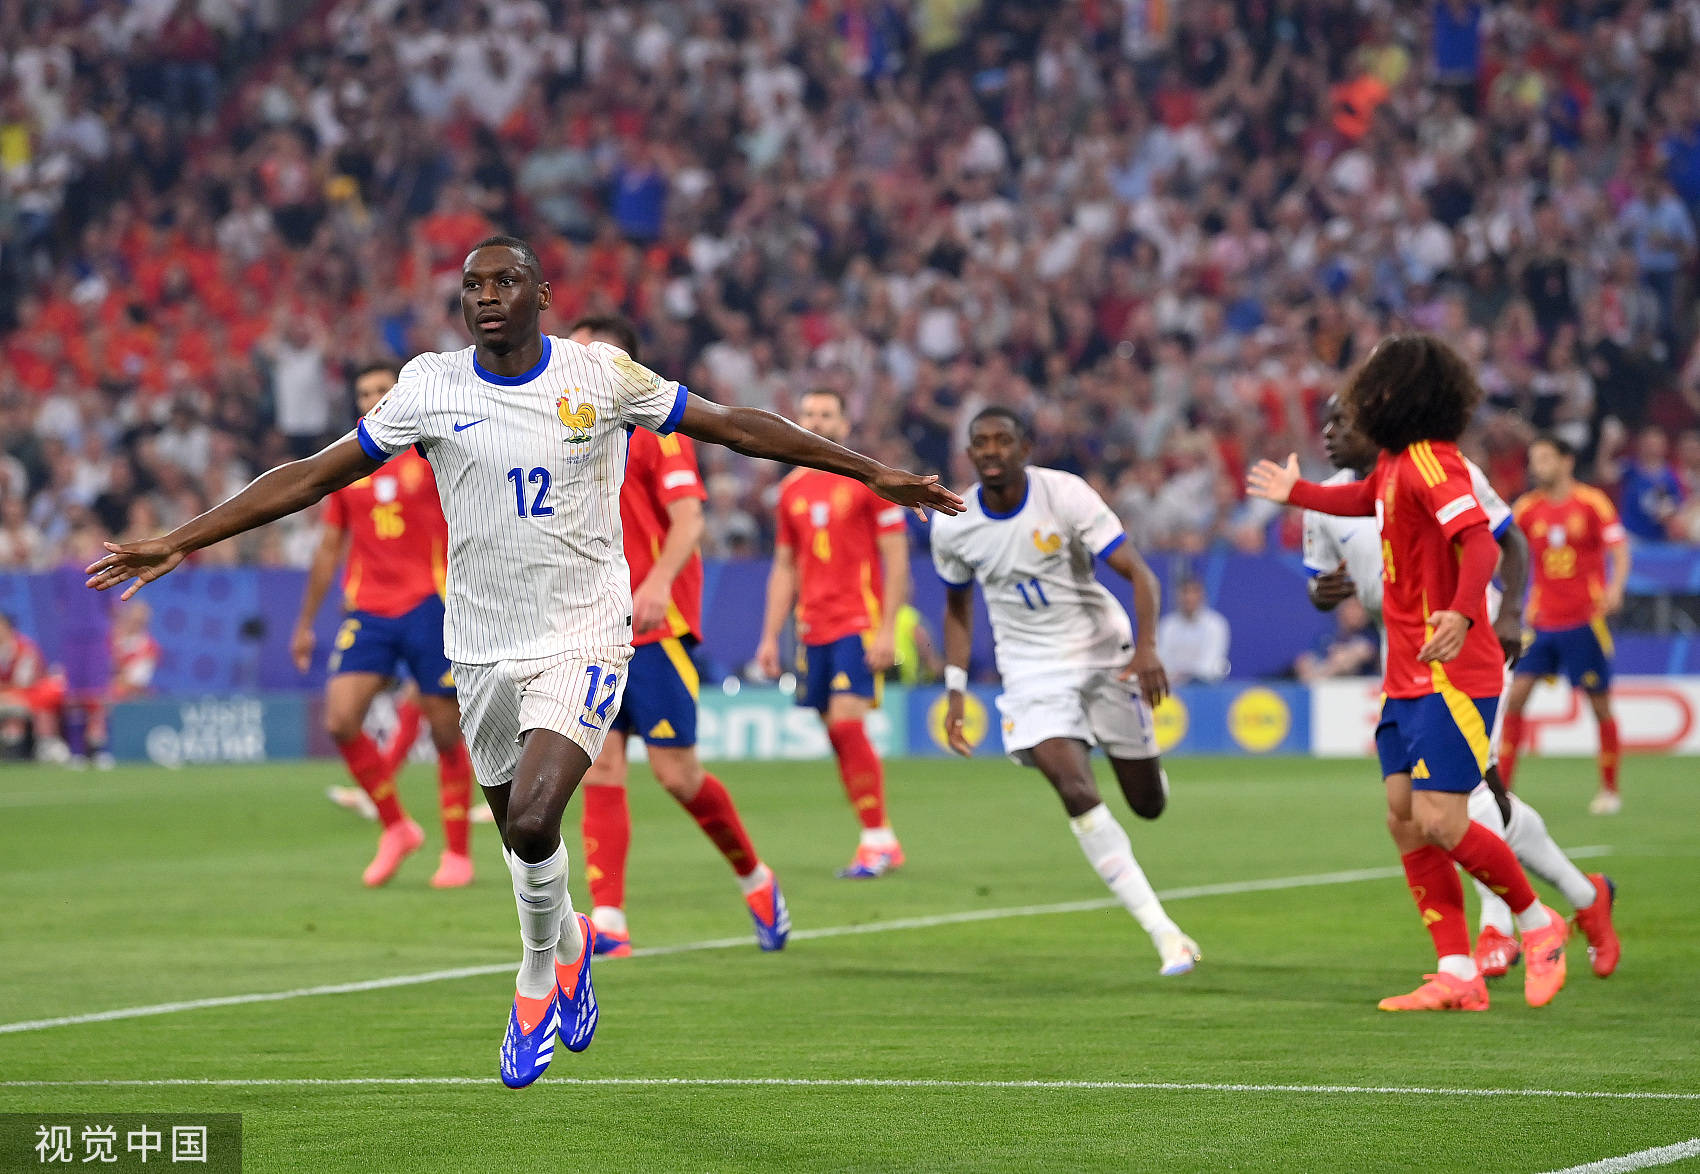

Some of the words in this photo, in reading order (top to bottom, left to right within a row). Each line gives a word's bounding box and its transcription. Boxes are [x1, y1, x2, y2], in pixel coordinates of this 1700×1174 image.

[507, 466, 554, 518] 12
[1016, 577, 1050, 611] 11
[584, 665, 617, 725] 12
